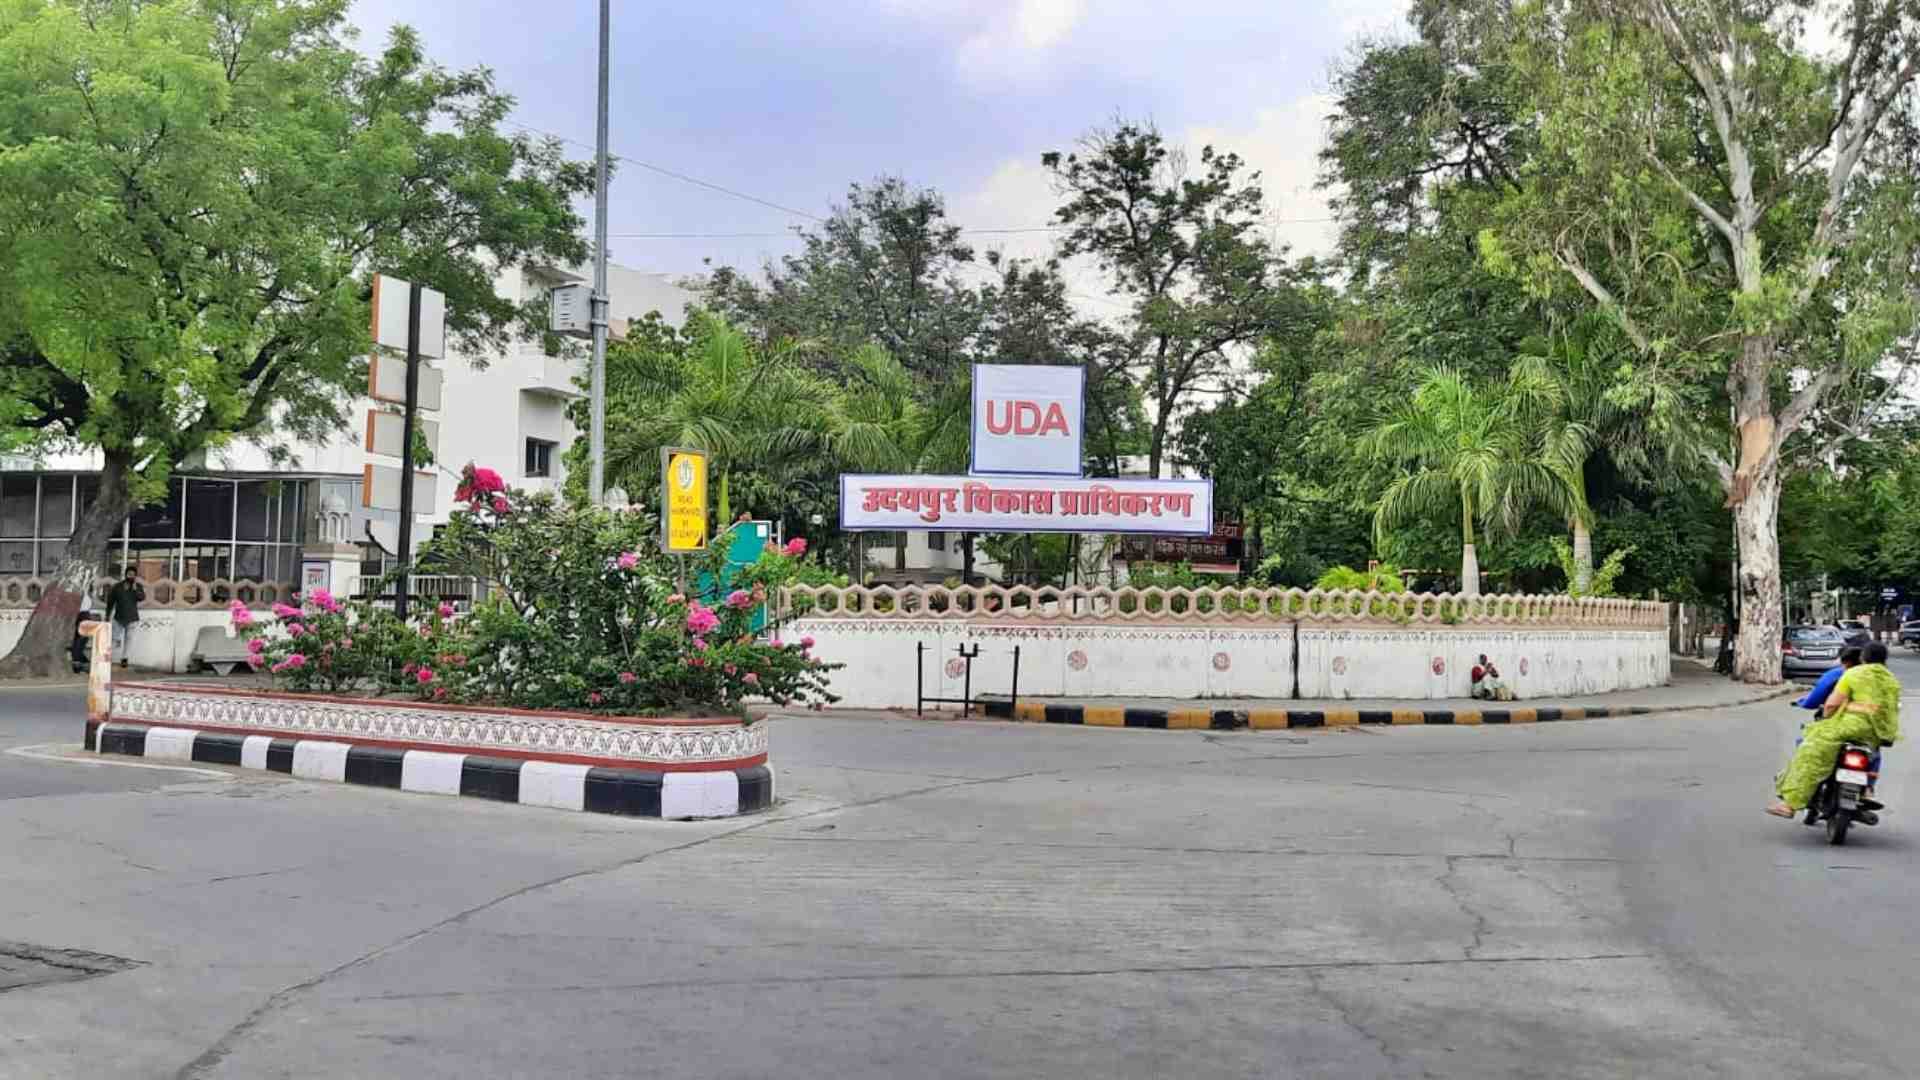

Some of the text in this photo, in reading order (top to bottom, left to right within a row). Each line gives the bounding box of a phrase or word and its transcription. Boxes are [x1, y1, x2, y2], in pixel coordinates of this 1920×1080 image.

[986, 400, 1070, 436] UDA
[861, 481, 1193, 522] उदयपुर विकास प्राधिकरण
